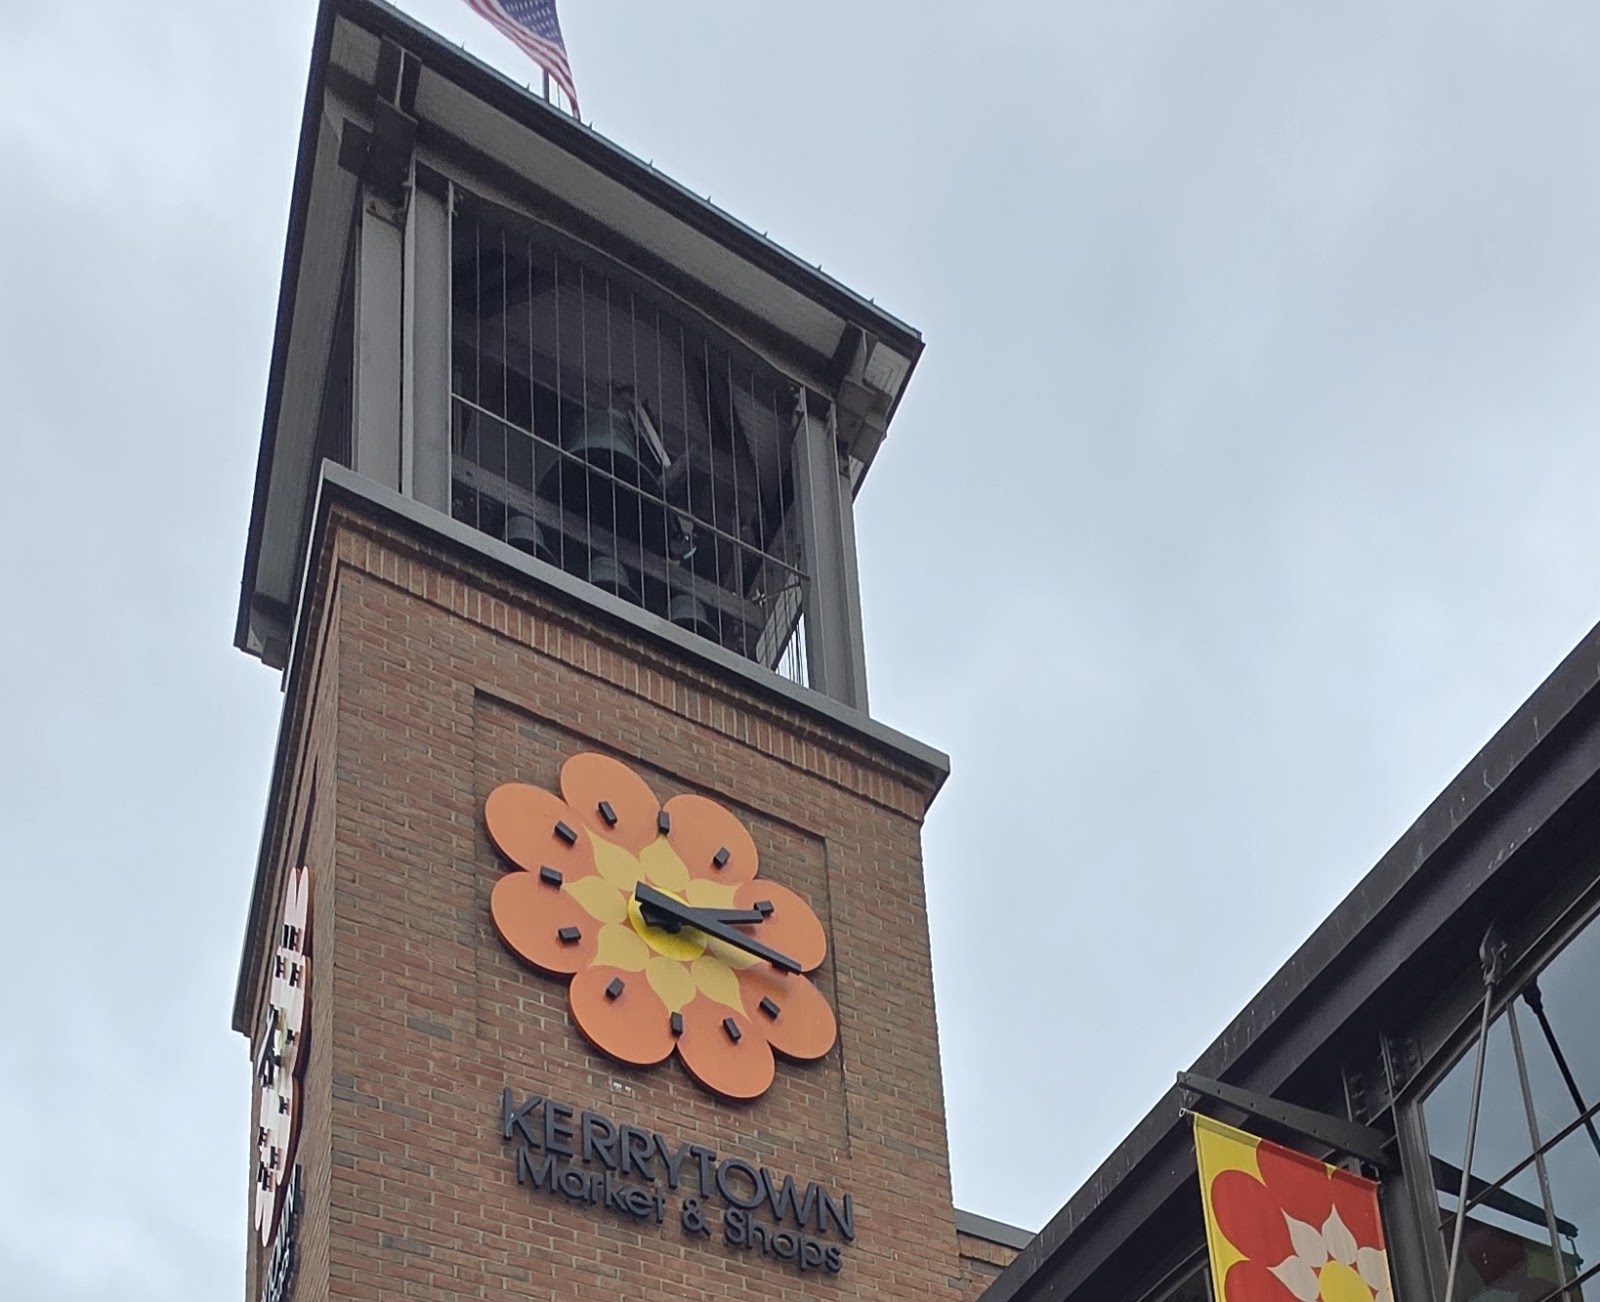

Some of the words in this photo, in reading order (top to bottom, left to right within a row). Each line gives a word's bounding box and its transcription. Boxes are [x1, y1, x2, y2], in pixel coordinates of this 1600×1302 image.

[502, 1086, 856, 1241] KERRYTOWN
[516, 1147, 665, 1224] Market
[681, 1196, 712, 1237] &
[724, 1206, 843, 1273] Shops
